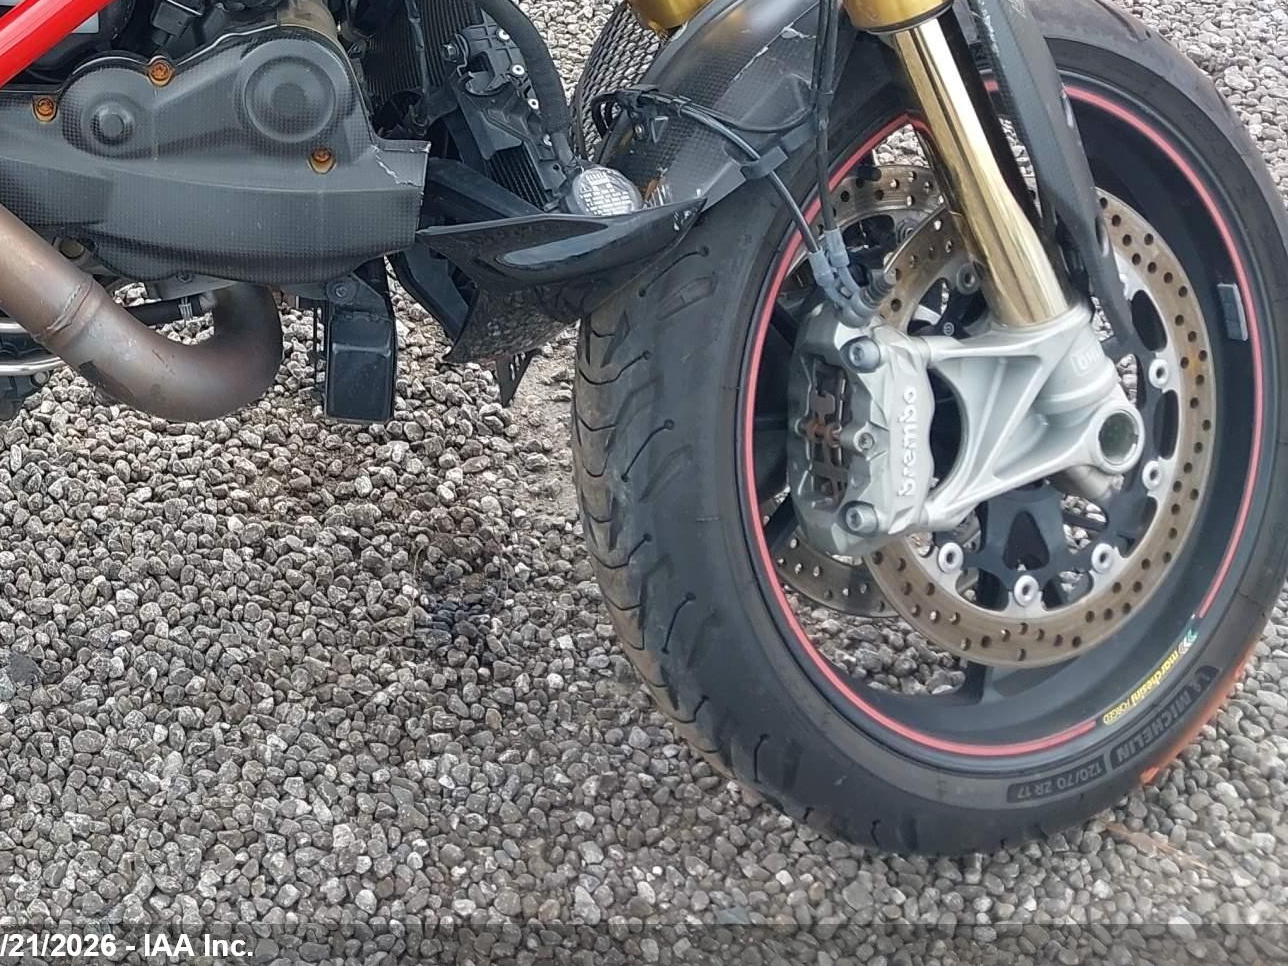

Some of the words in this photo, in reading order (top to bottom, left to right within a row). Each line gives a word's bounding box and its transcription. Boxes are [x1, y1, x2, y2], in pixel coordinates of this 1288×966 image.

[896, 386, 918, 496] brembo
[1129, 649, 1179, 707] marchesini
[1115, 689, 1193, 763] MICHELIN
[1033, 780, 1053, 796] ZR
[1056, 762, 1104, 790] 120/70
